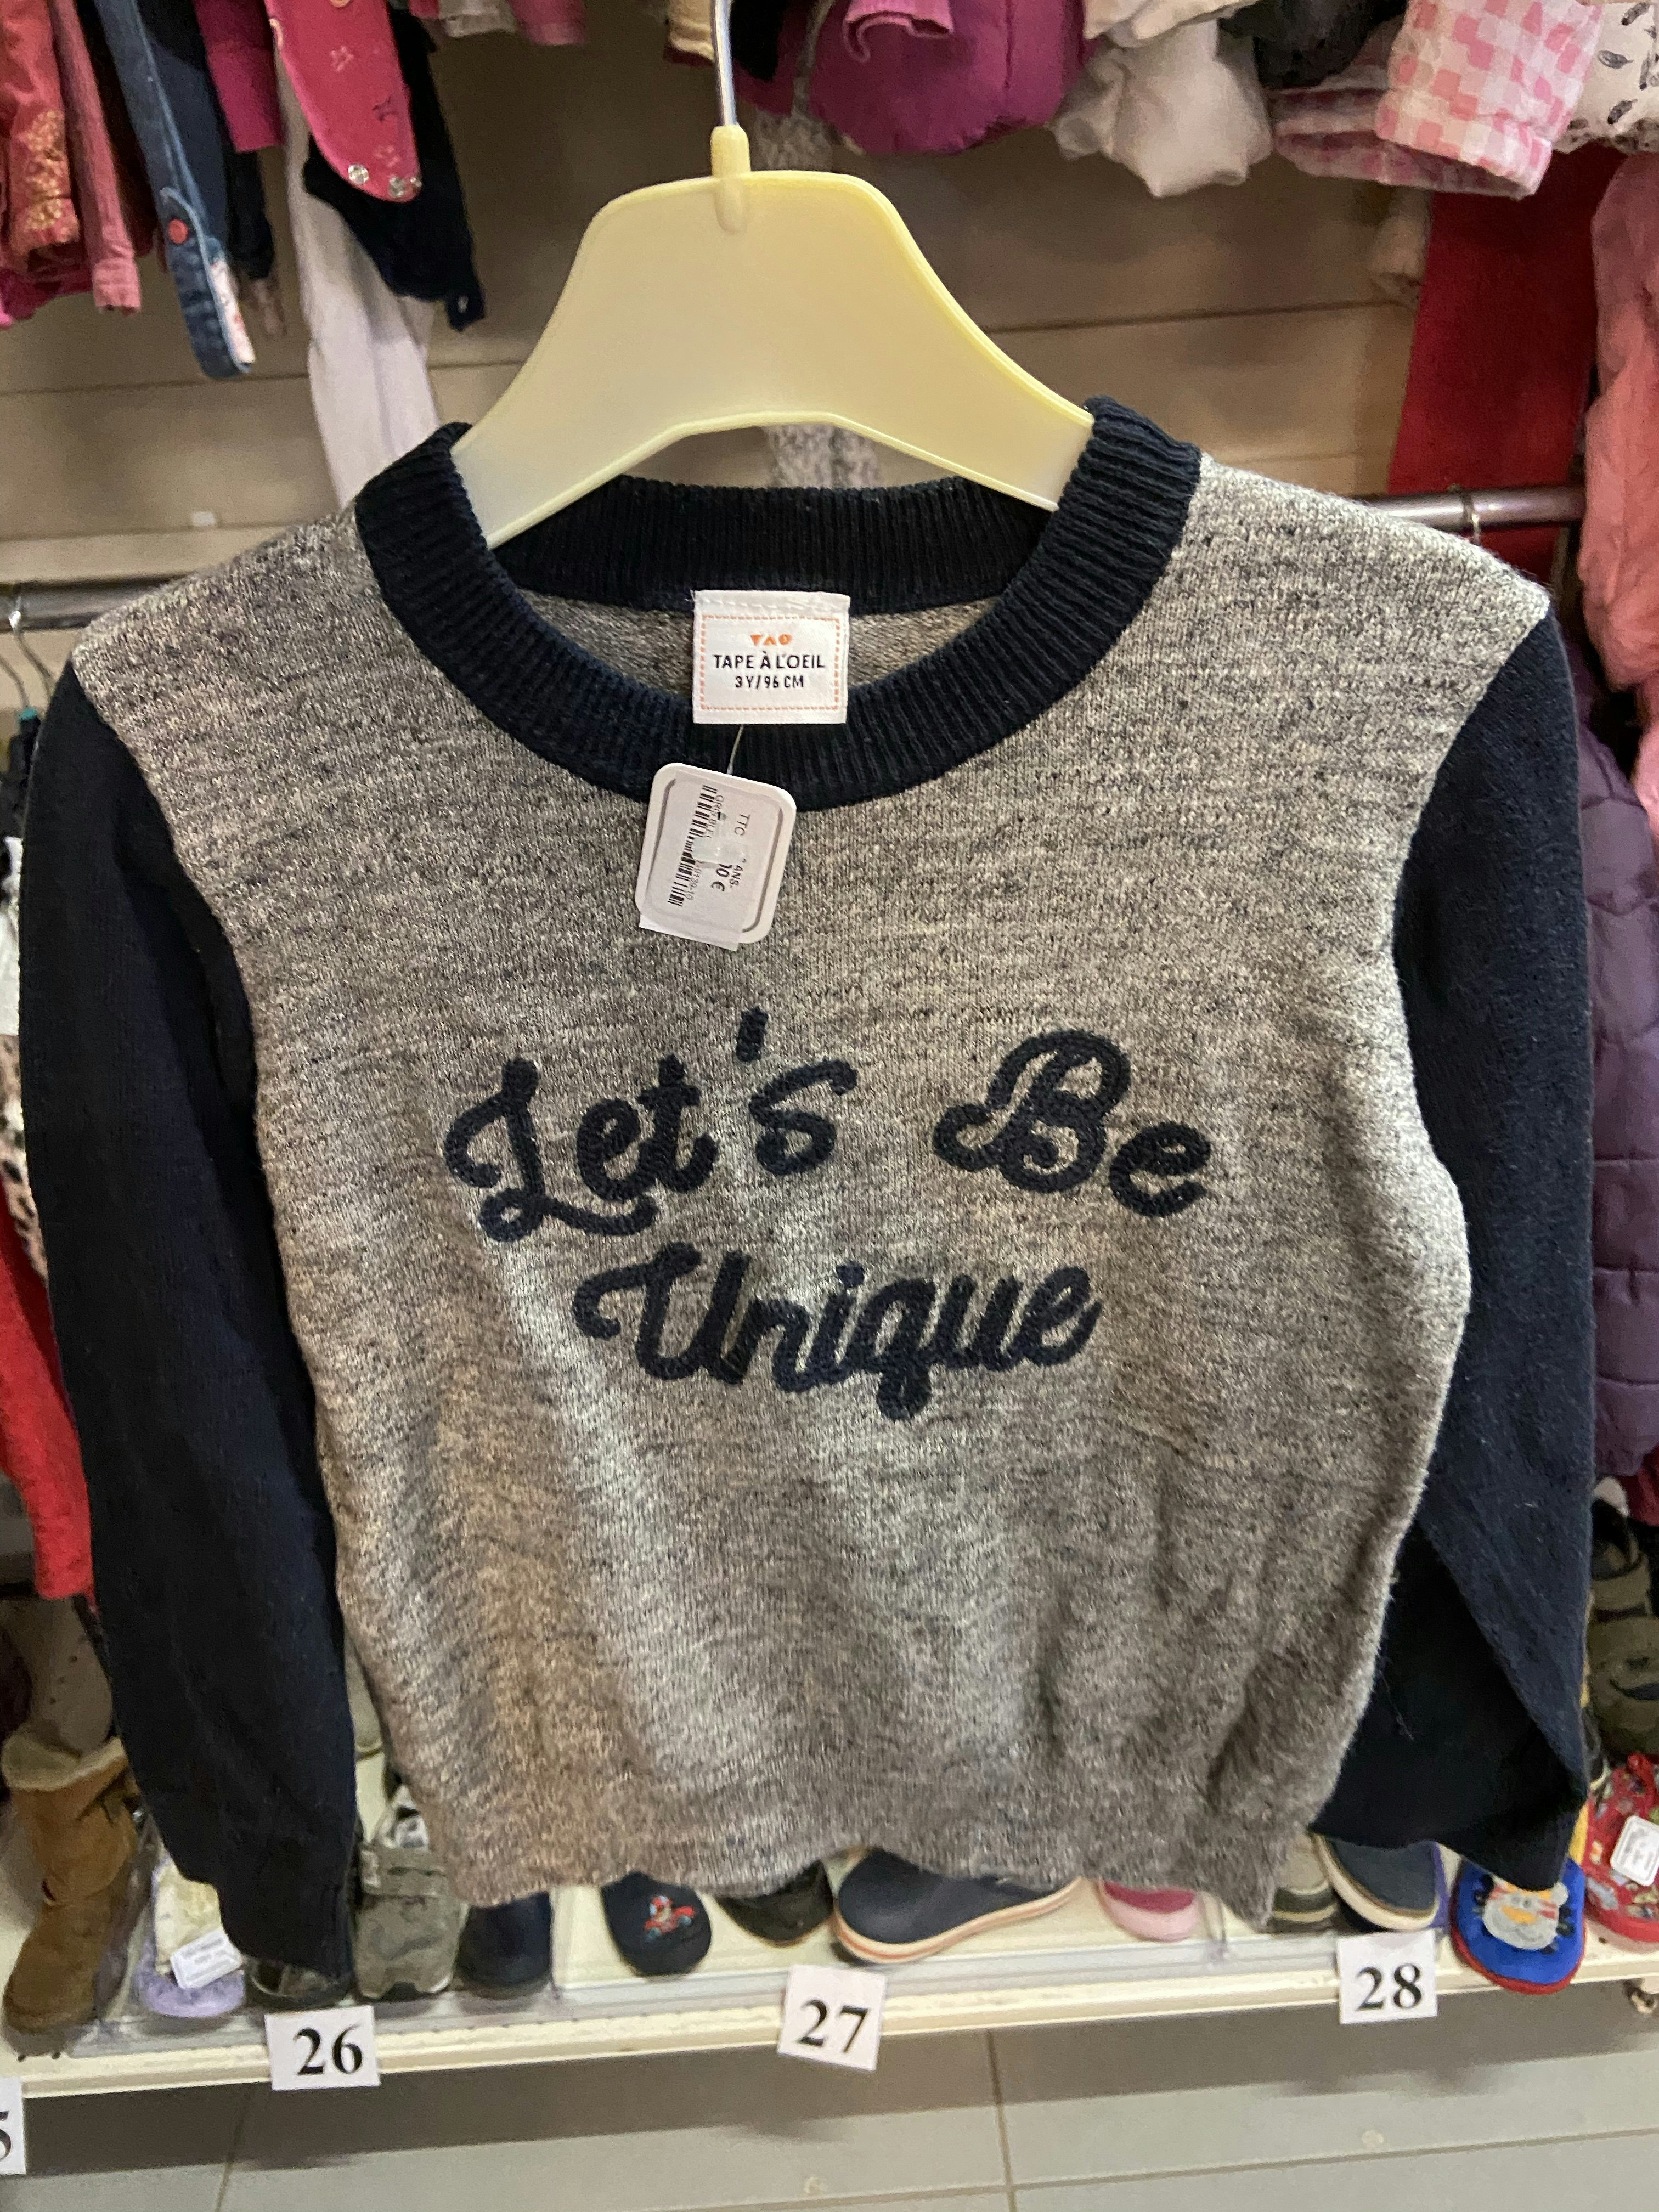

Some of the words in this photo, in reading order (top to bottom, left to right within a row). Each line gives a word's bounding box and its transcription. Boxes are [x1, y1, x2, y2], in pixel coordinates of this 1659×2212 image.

[713, 654, 755, 669] TAPE
[760, 650, 771, 669] À
[750, 634, 792, 646] TAO
[784, 675, 804, 688] CM
[734, 814, 751, 836] TTC
[443, 1007, 858, 1242] Let's
[933, 1029, 1211, 1218] Be
[573, 1241, 1101, 1423] Unique
[1356, 1963, 1423, 2012] 28
[293, 2025, 363, 2076] 26
[797, 2000, 870, 2053] 27
